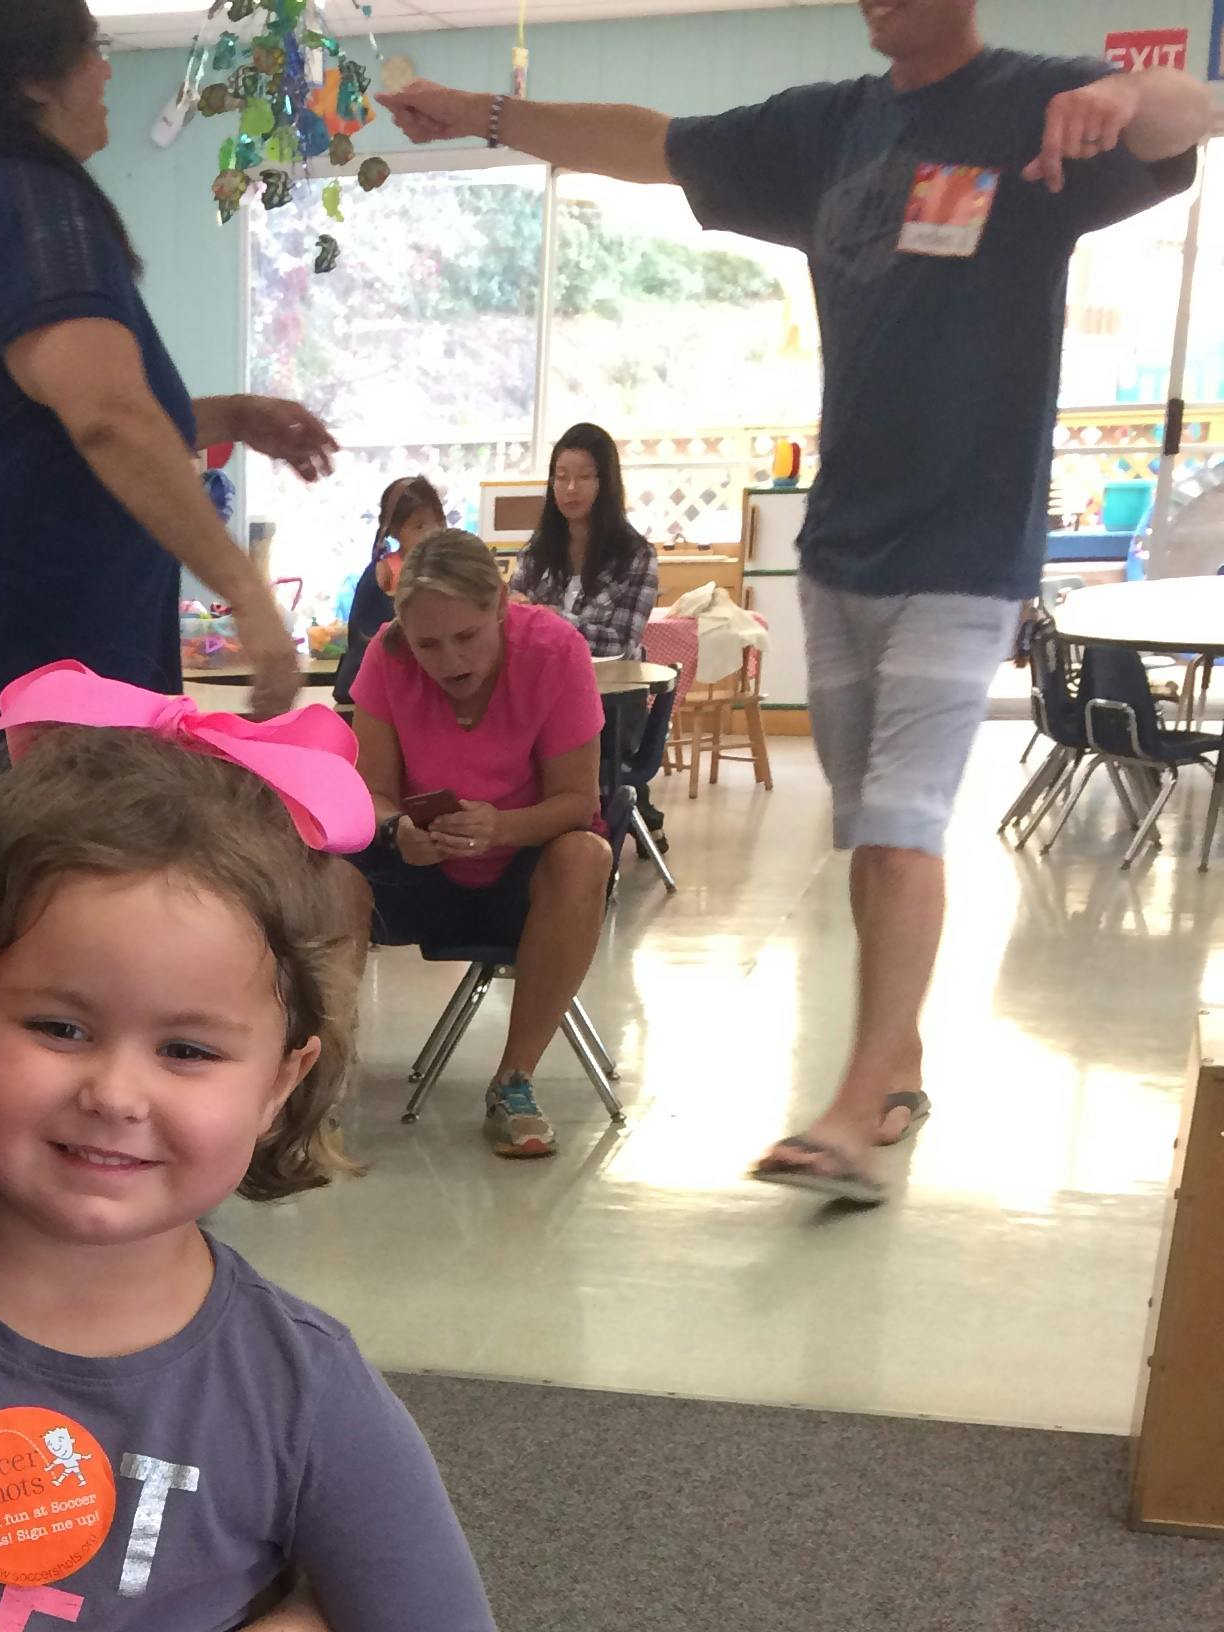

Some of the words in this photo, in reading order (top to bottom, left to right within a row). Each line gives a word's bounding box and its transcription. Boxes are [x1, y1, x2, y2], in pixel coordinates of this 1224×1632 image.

[1105, 44, 1184, 73] EXIT
[4, 1511, 30, 1526] fun
[33, 1504, 48, 1518] at
[50, 1493, 97, 1514] Soccer
[16, 1525, 49, 1543] Sign
[52, 1519, 74, 1533] me
[76, 1510, 101, 1527] up!
